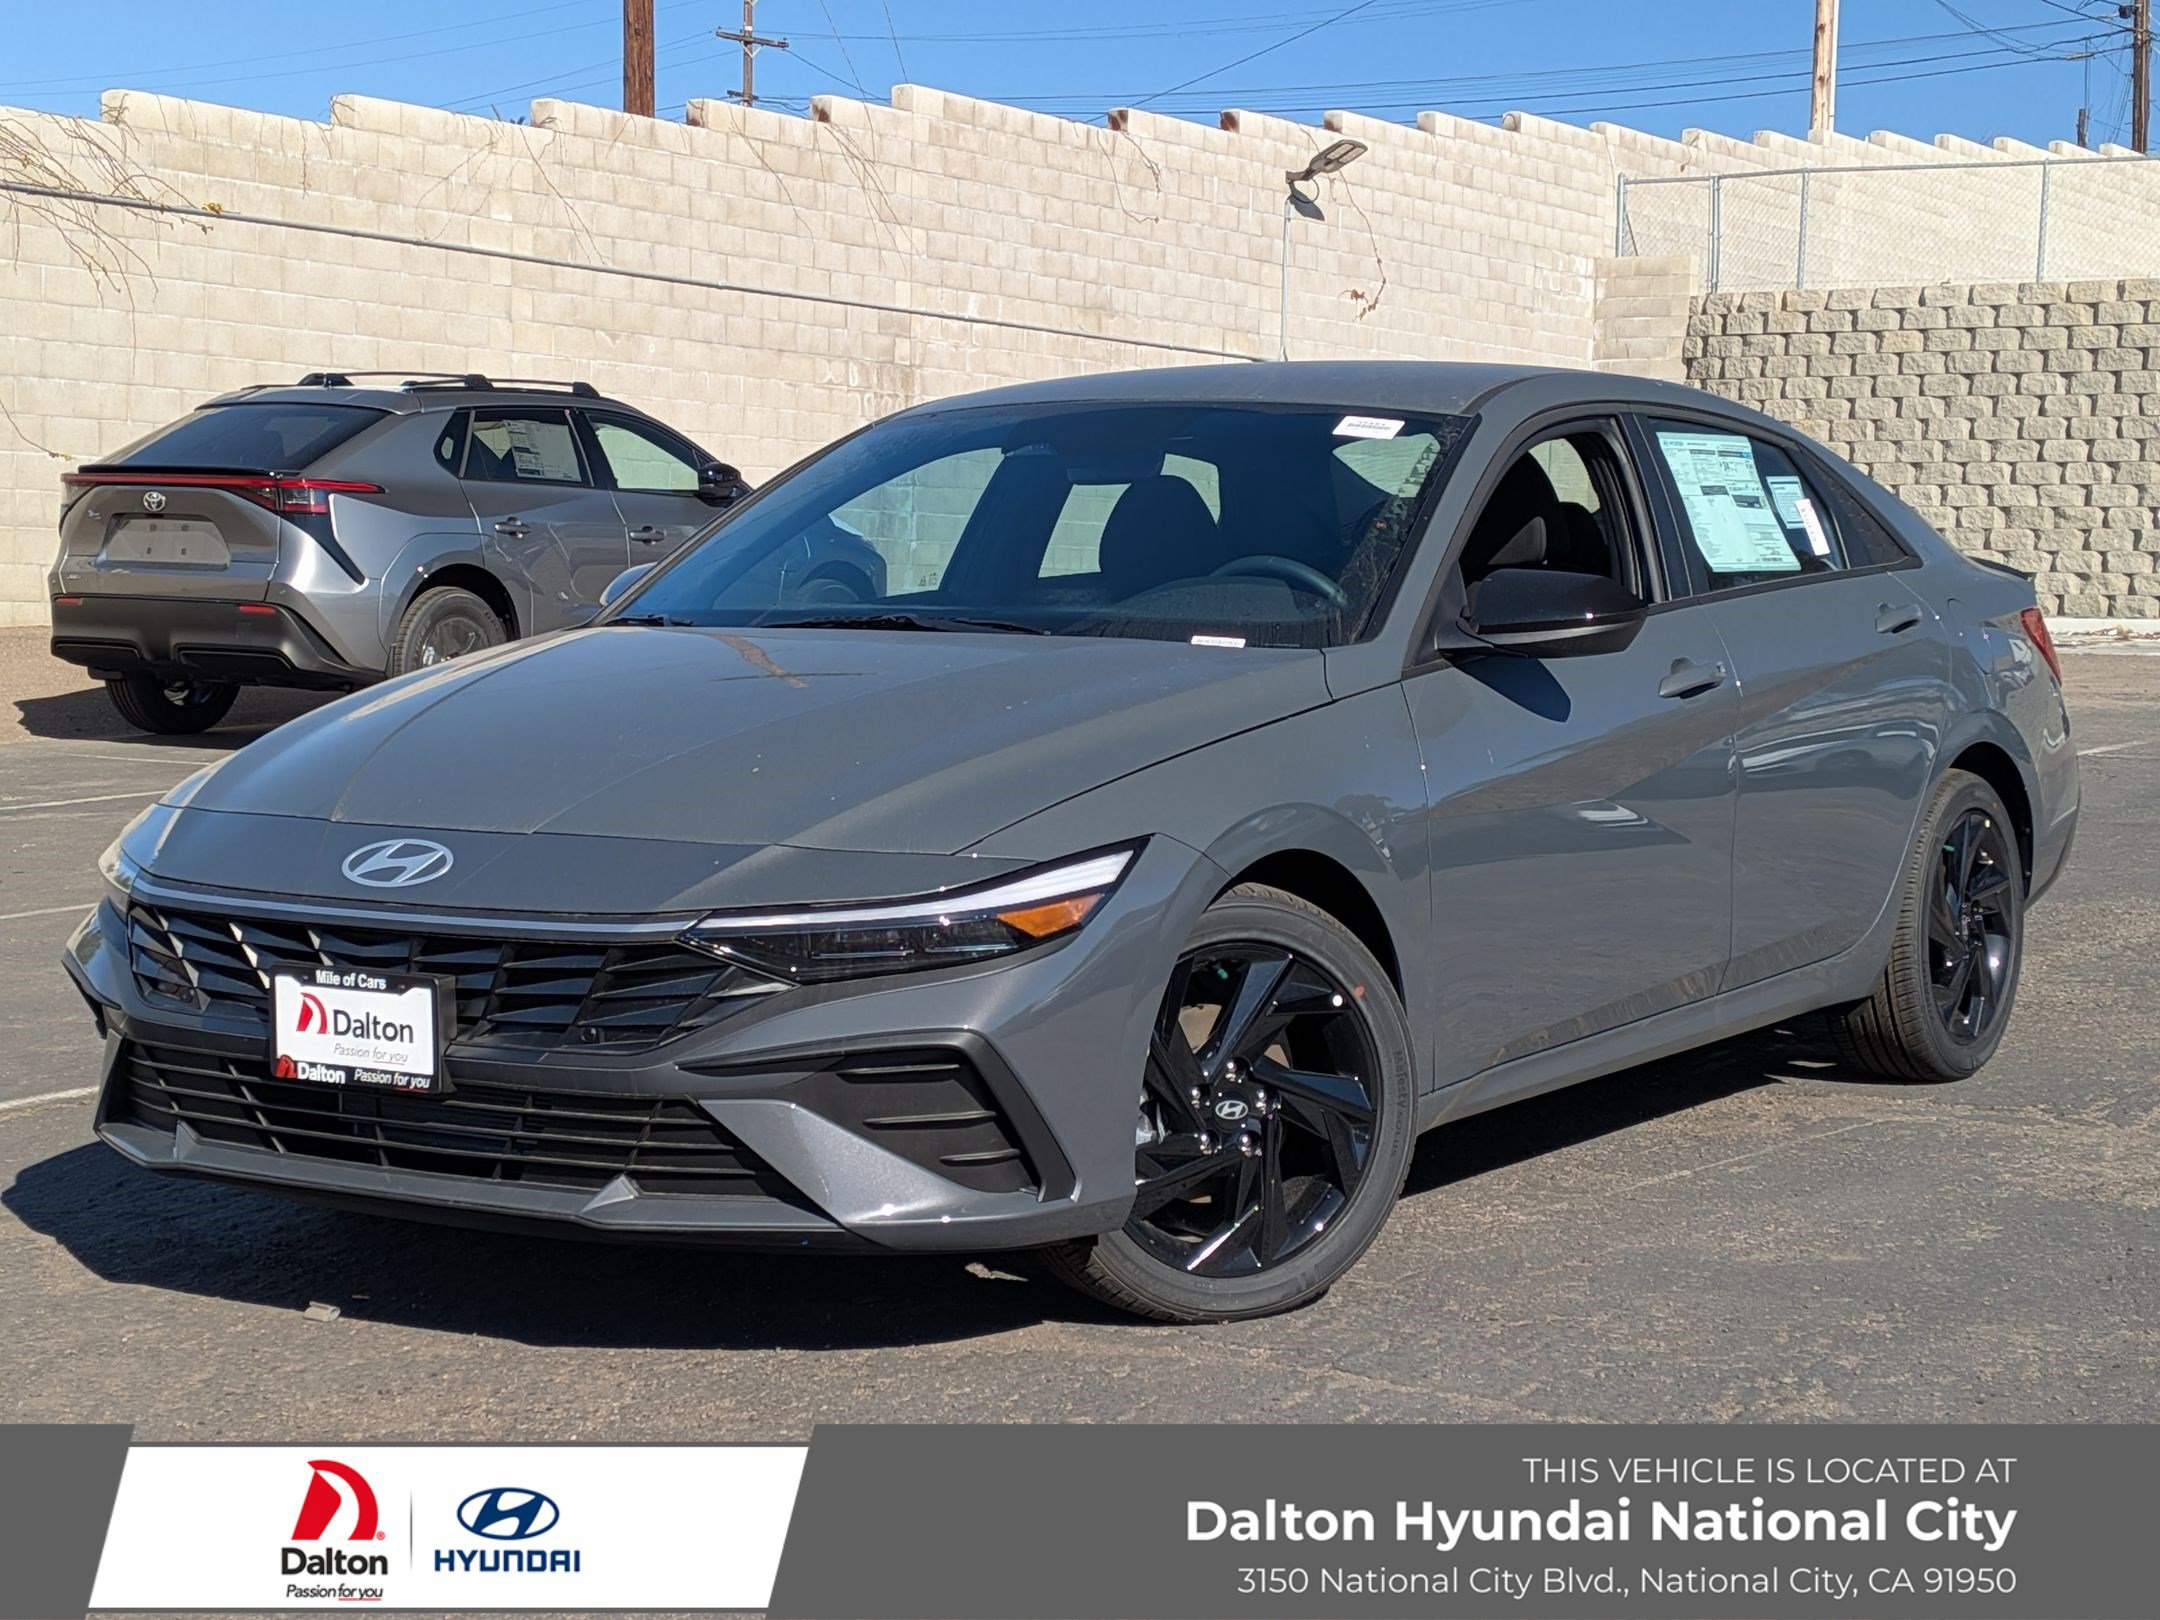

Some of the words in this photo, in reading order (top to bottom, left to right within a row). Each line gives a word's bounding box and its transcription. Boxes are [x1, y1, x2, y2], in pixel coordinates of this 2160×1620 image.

[316, 970, 340, 986] Mile
[343, 973, 355, 987] of
[357, 974, 386, 990] Cars
[333, 1009, 414, 1044] Dalton
[333, 1043, 370, 1059] Passion
[372, 1047, 387, 1061] for
[389, 1051, 408, 1063] you
[297, 1062, 346, 1085] Dalton
[354, 1069, 391, 1084] Passion
[393, 1072, 409, 1087] for
[410, 1076, 431, 1090] you
